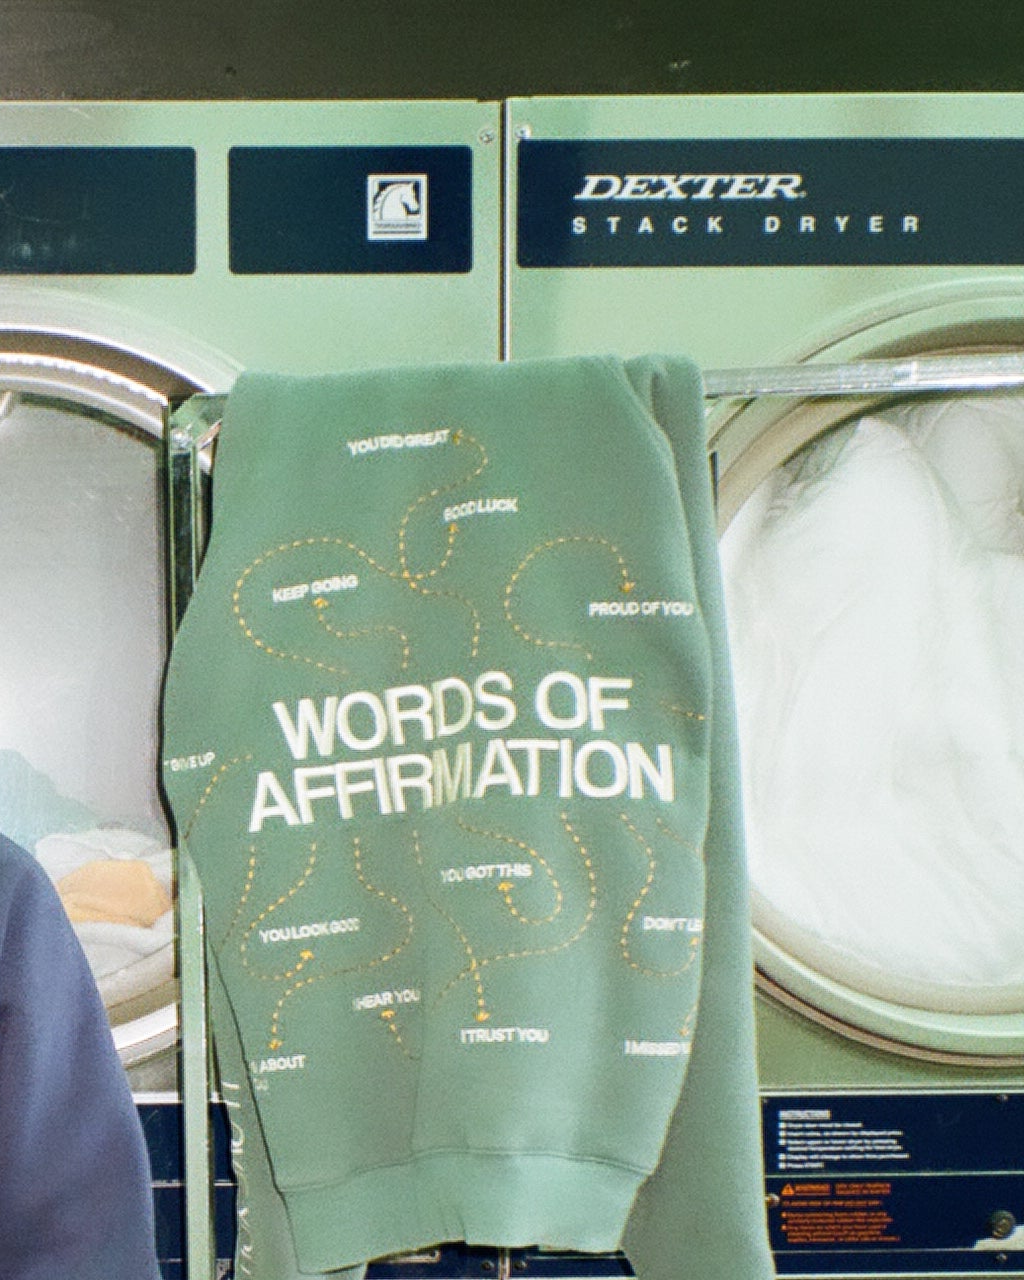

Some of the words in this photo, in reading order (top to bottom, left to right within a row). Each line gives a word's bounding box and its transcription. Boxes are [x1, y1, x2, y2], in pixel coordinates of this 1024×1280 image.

[574, 174, 803, 201] DEXTER
[572, 216, 724, 235] STACK
[765, 215, 920, 234] DRYER
[347, 437, 379, 456] YOU
[379, 434, 404, 449] DID
[404, 429, 450, 447] GREAT
[476, 497, 519, 513] LUCK
[273, 584, 309, 603] KEEP
[311, 573, 358, 594] GOING
[589, 601, 639, 617] PROUD
[641, 601, 660, 616] OF
[661, 601, 694, 616] YOU
[272, 671, 517, 760] WORDS
[535, 670, 633, 731] OF
[198, 751, 215, 767] UP
[248, 739, 675, 833] AFFIRMATION
[465, 865, 496, 880] GOT
[497, 863, 532, 878] THIS
[259, 927, 291, 944] YOU
[291, 921, 330, 940] LOOK
[356, 991, 394, 1010] HEAR
[393, 988, 420, 1004] YOU
[465, 1027, 516, 1043] TRUST
[516, 1026, 550, 1043] YOU
[259, 1053, 306, 1073] ABOUT
